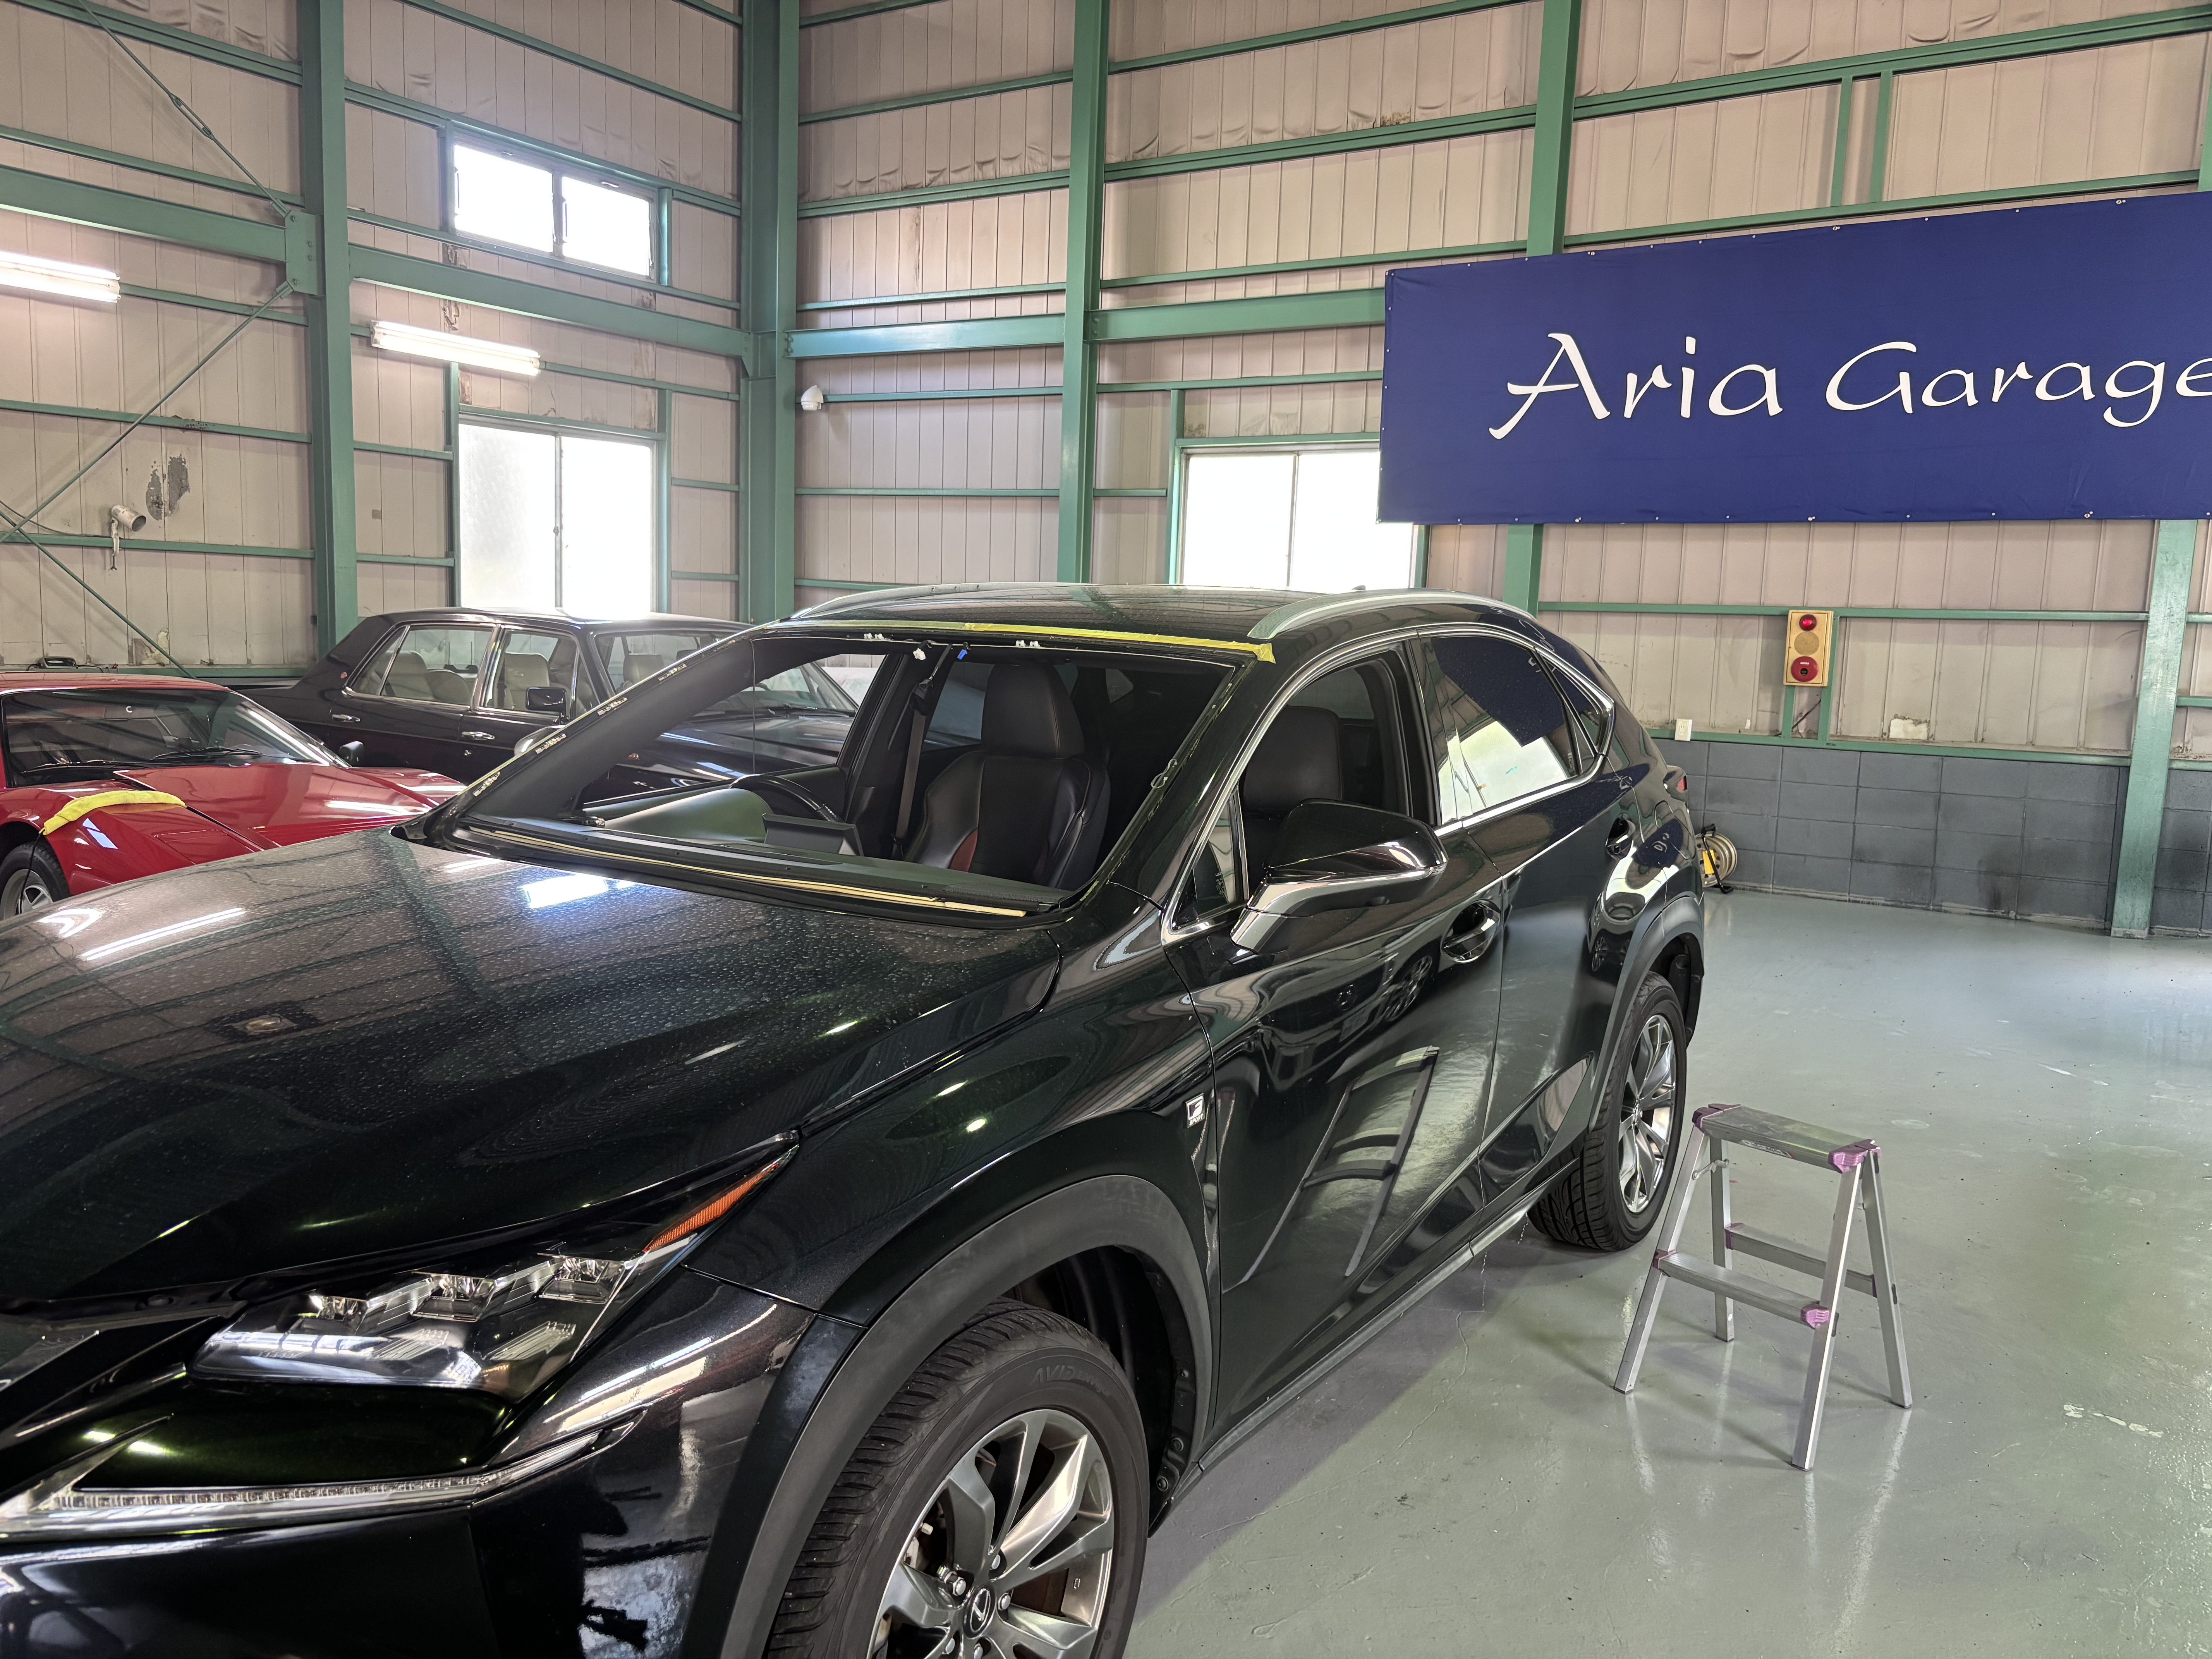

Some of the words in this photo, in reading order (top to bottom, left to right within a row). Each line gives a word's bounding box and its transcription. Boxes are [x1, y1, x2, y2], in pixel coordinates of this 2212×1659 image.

[1489, 333, 1784, 440] Aria
[1825, 341, 2212, 428] Garage
[1189, 1113, 1204, 1126] SPORT
[1029, 1364, 1075, 1385] AVID
